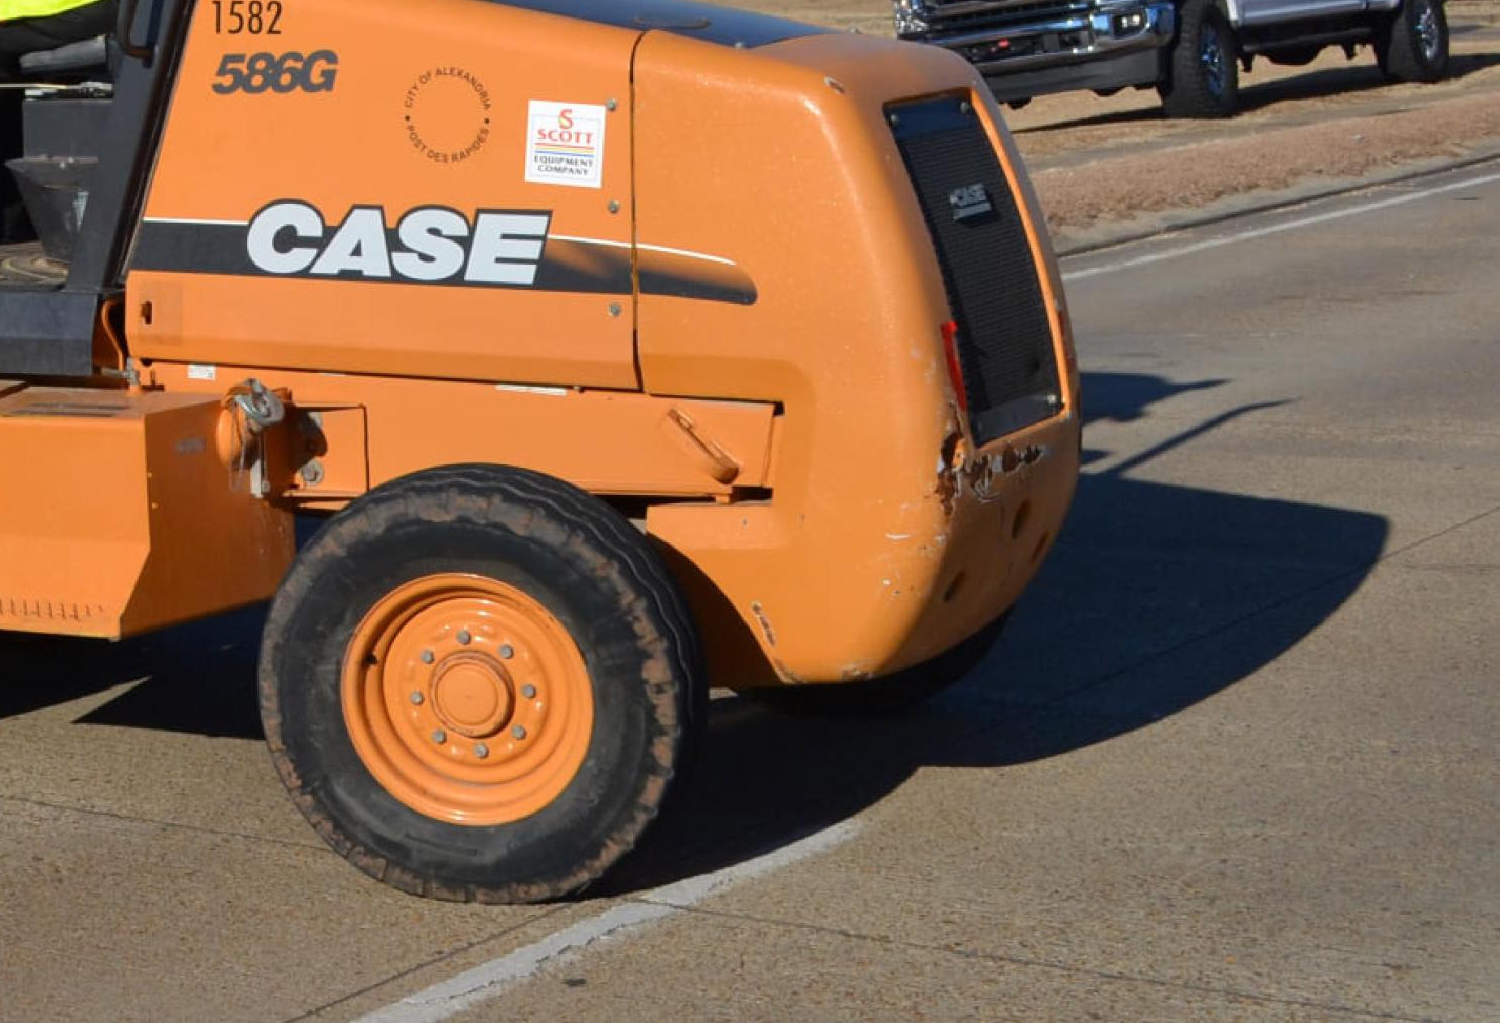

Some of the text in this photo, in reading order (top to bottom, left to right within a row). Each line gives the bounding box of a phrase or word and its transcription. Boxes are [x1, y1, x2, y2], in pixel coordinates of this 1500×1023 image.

[212, 0, 283, 34] 1582
[212, 50, 338, 94] 586G
[436, 67, 491, 110] ALEXANDRIA
[537, 129, 594, 145] SCOTT
[534, 155, 594, 168] EQUIPMENT
[538, 165, 589, 176] COMPANY
[246, 199, 552, 286] CASE
